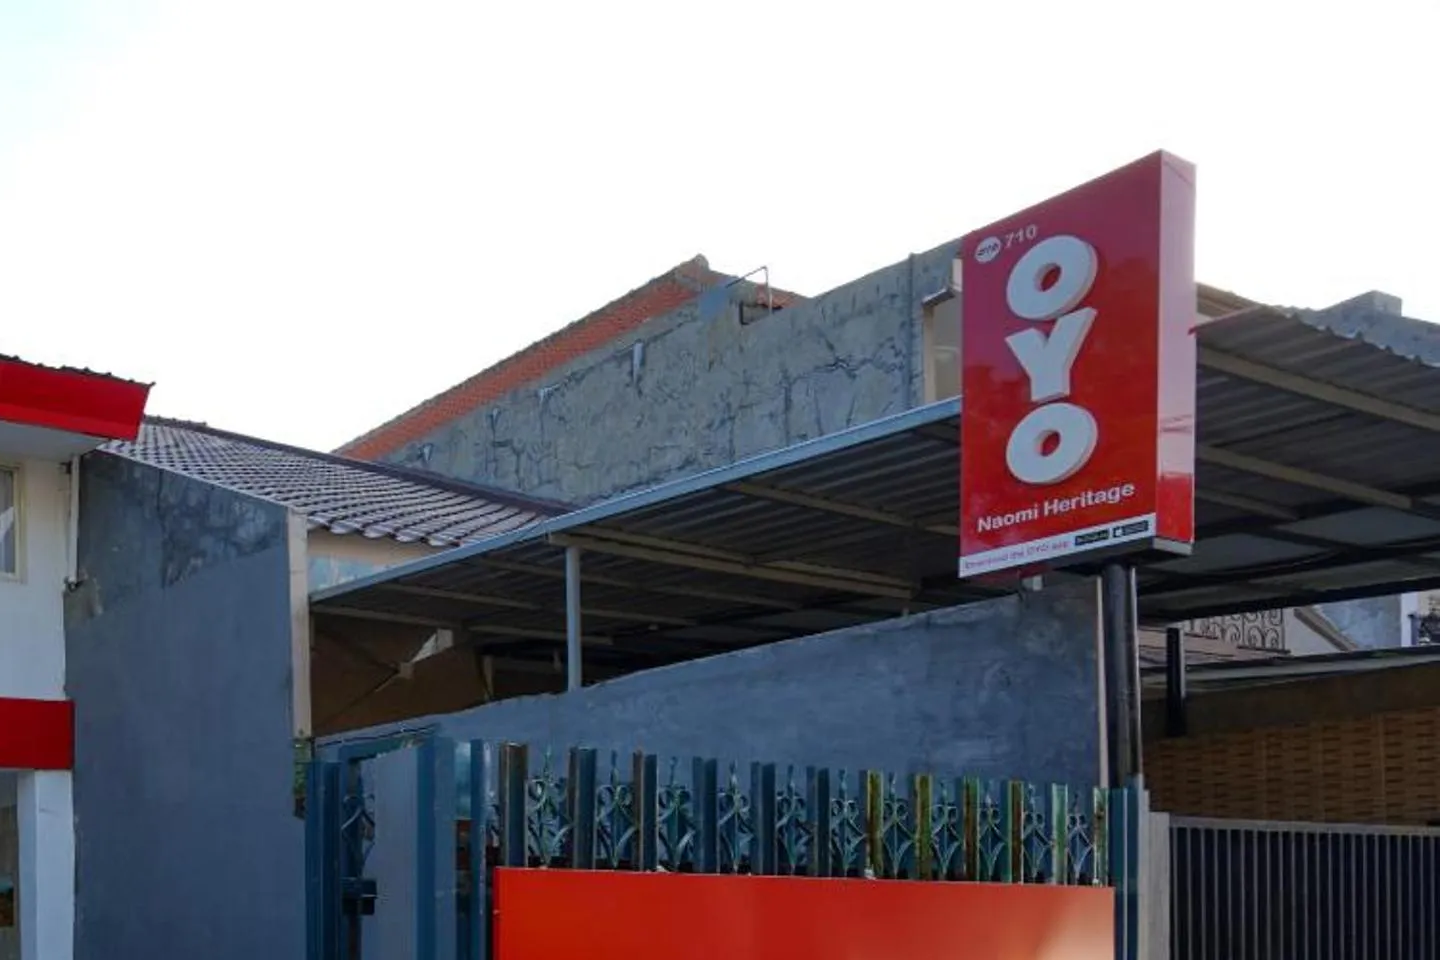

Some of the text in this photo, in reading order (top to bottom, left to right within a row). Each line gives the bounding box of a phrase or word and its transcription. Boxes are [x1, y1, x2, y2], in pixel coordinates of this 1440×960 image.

[1004, 224, 1038, 249] 710
[1005, 234, 1099, 484] OYO
[977, 483, 1136, 533] Naomi Heritage
